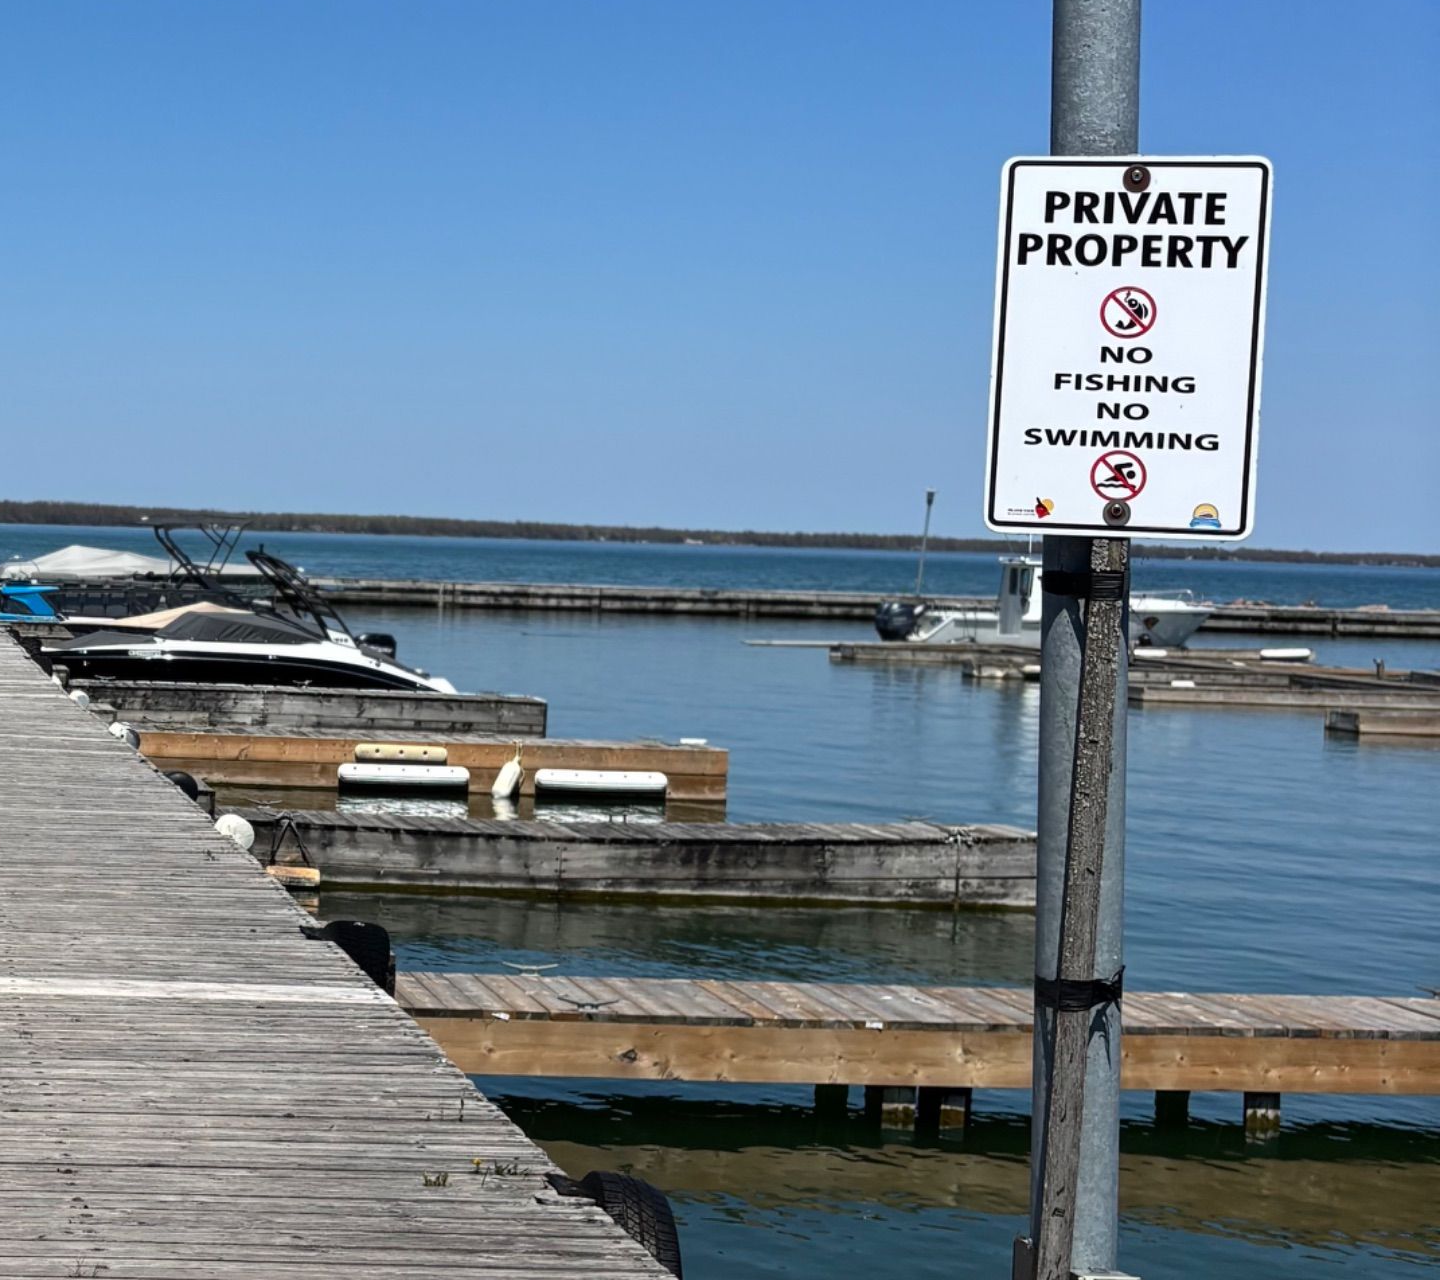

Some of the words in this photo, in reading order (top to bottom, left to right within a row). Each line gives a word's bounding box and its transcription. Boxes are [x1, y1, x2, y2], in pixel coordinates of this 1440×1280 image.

[1045, 191, 1227, 225] PRIVATE
[1017, 233, 1249, 268] PROPERTY
[1100, 346, 1153, 364] NO
[1054, 374, 1196, 393] FISHING
[1096, 403, 1150, 420] NO
[1024, 428, 1220, 451] SWIMMING
